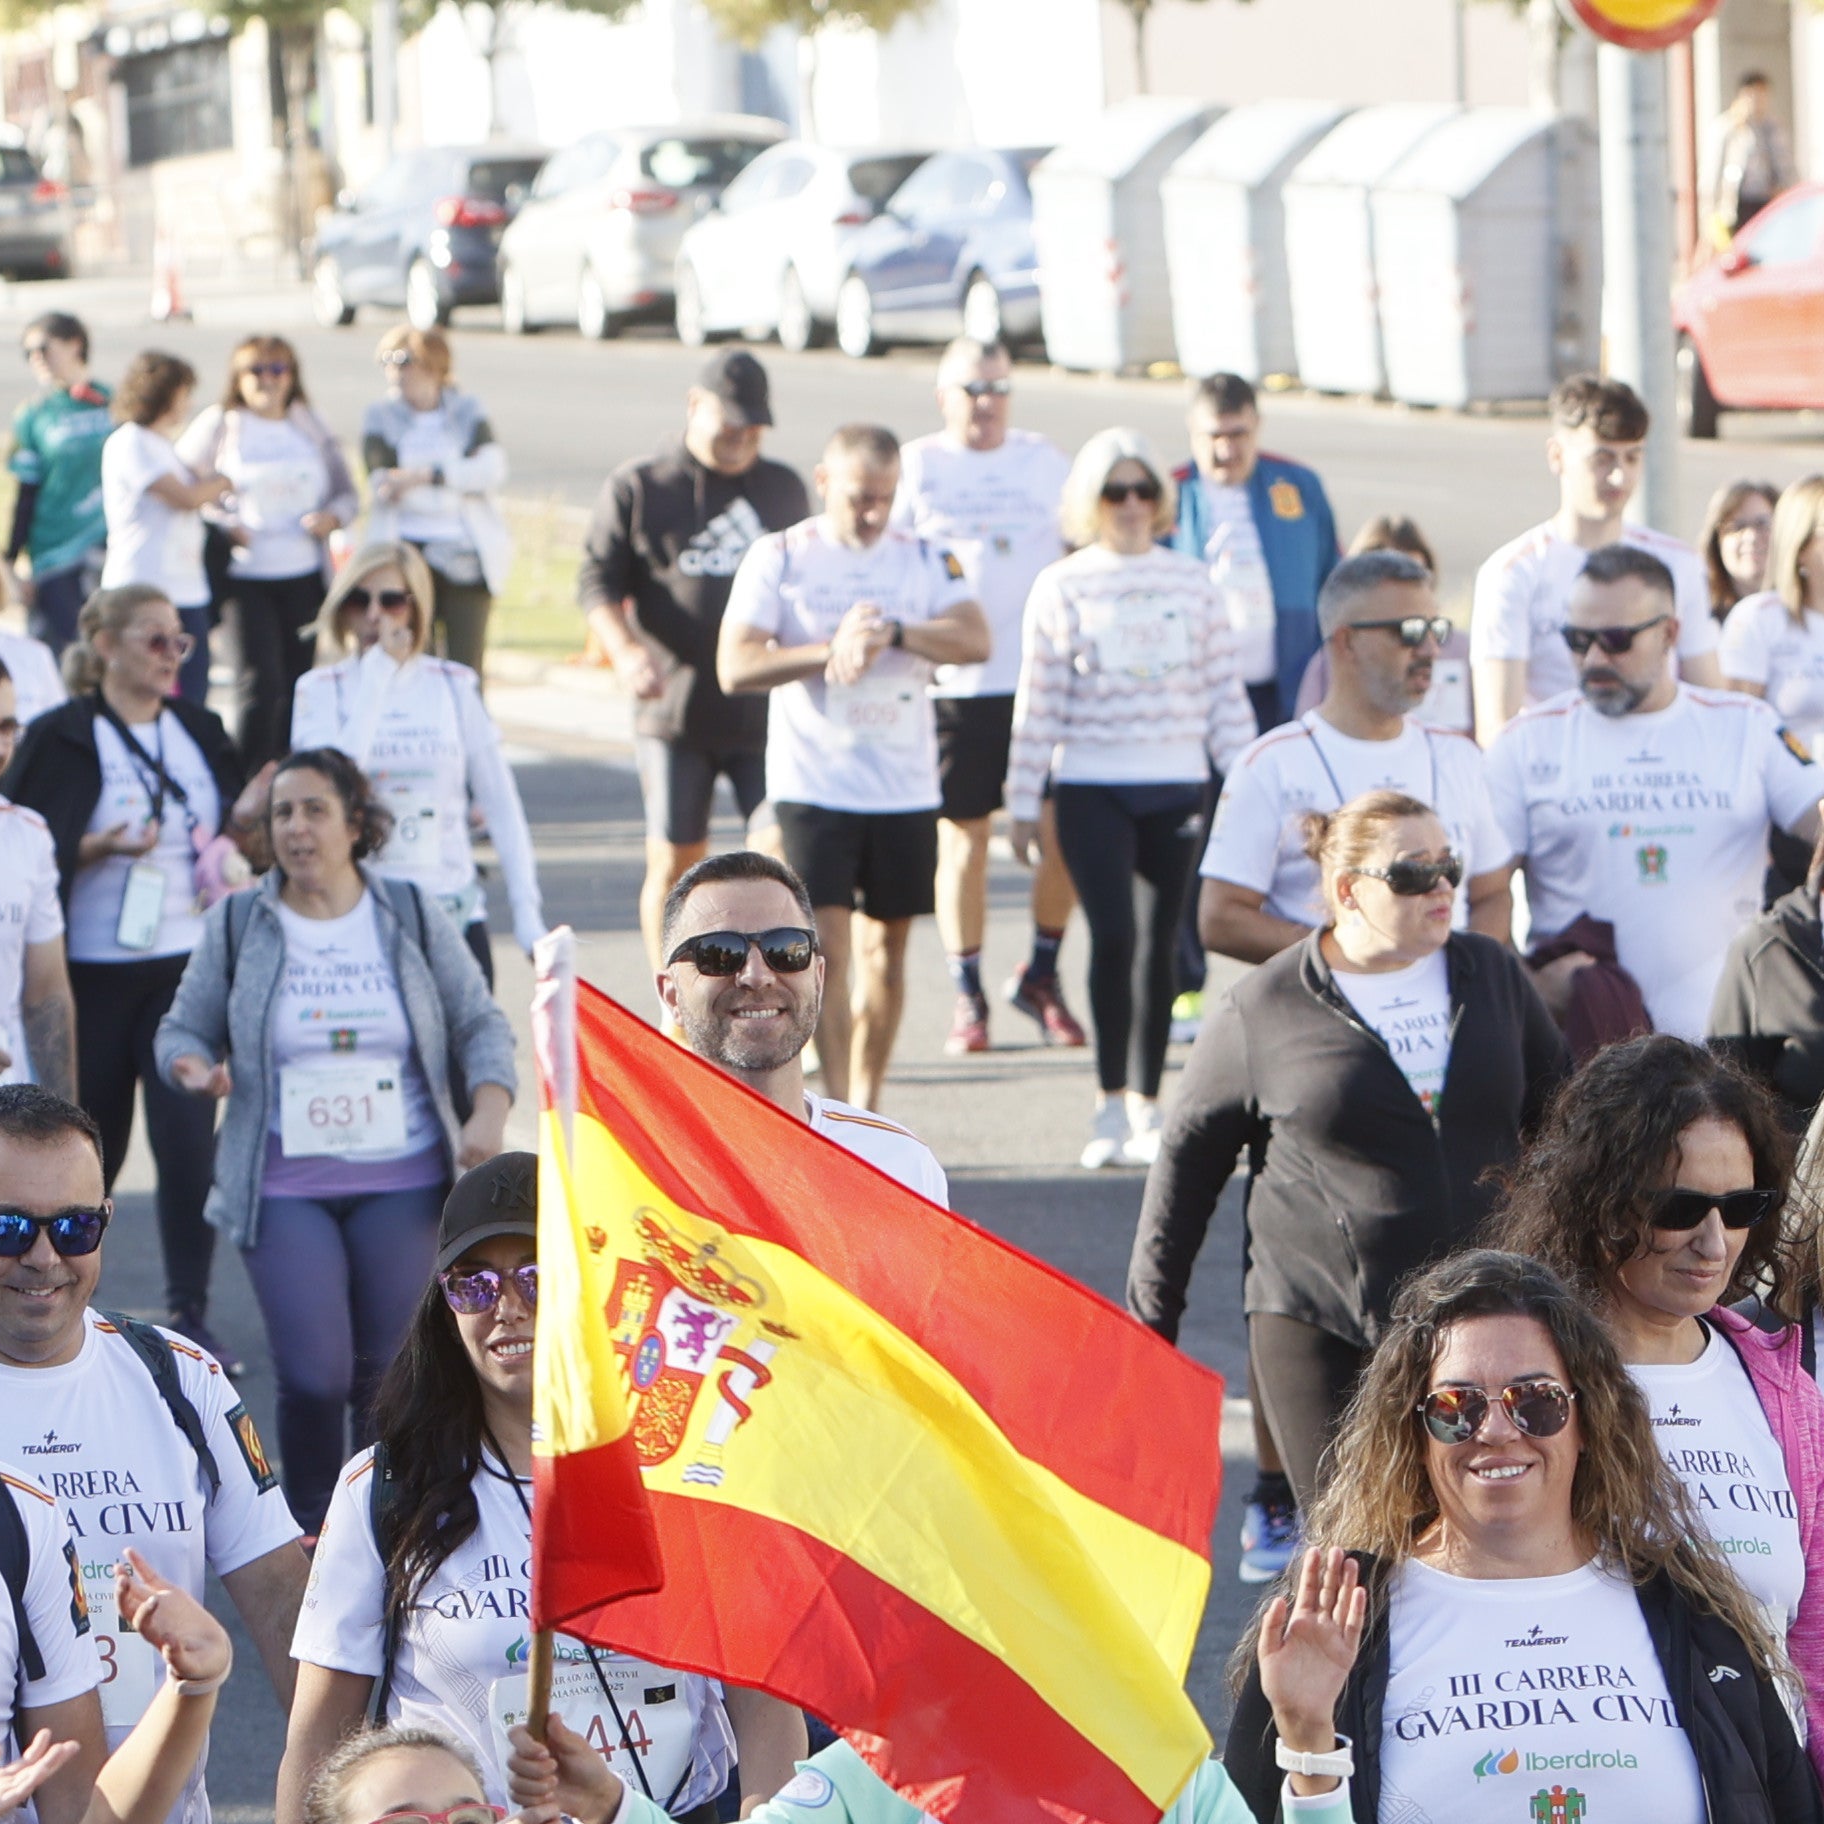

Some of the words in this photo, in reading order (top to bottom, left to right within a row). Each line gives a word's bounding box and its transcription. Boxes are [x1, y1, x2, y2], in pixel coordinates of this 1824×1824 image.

[1622, 770, 1703, 790] CARRERA
[1670, 787, 1734, 811] CIVIL
[307, 1092, 376, 1130] 631
[22, 1442, 82, 1455] TEAMERGY
[99, 1501, 193, 1535] CIVIL
[482, 1553, 511, 1582] III
[1504, 1636, 1568, 1648] TEAMERGY
[1449, 1673, 1483, 1697] III
[1495, 1664, 1636, 1692] CARRERA
[1526, 1749, 1637, 1771] Iberdrola
